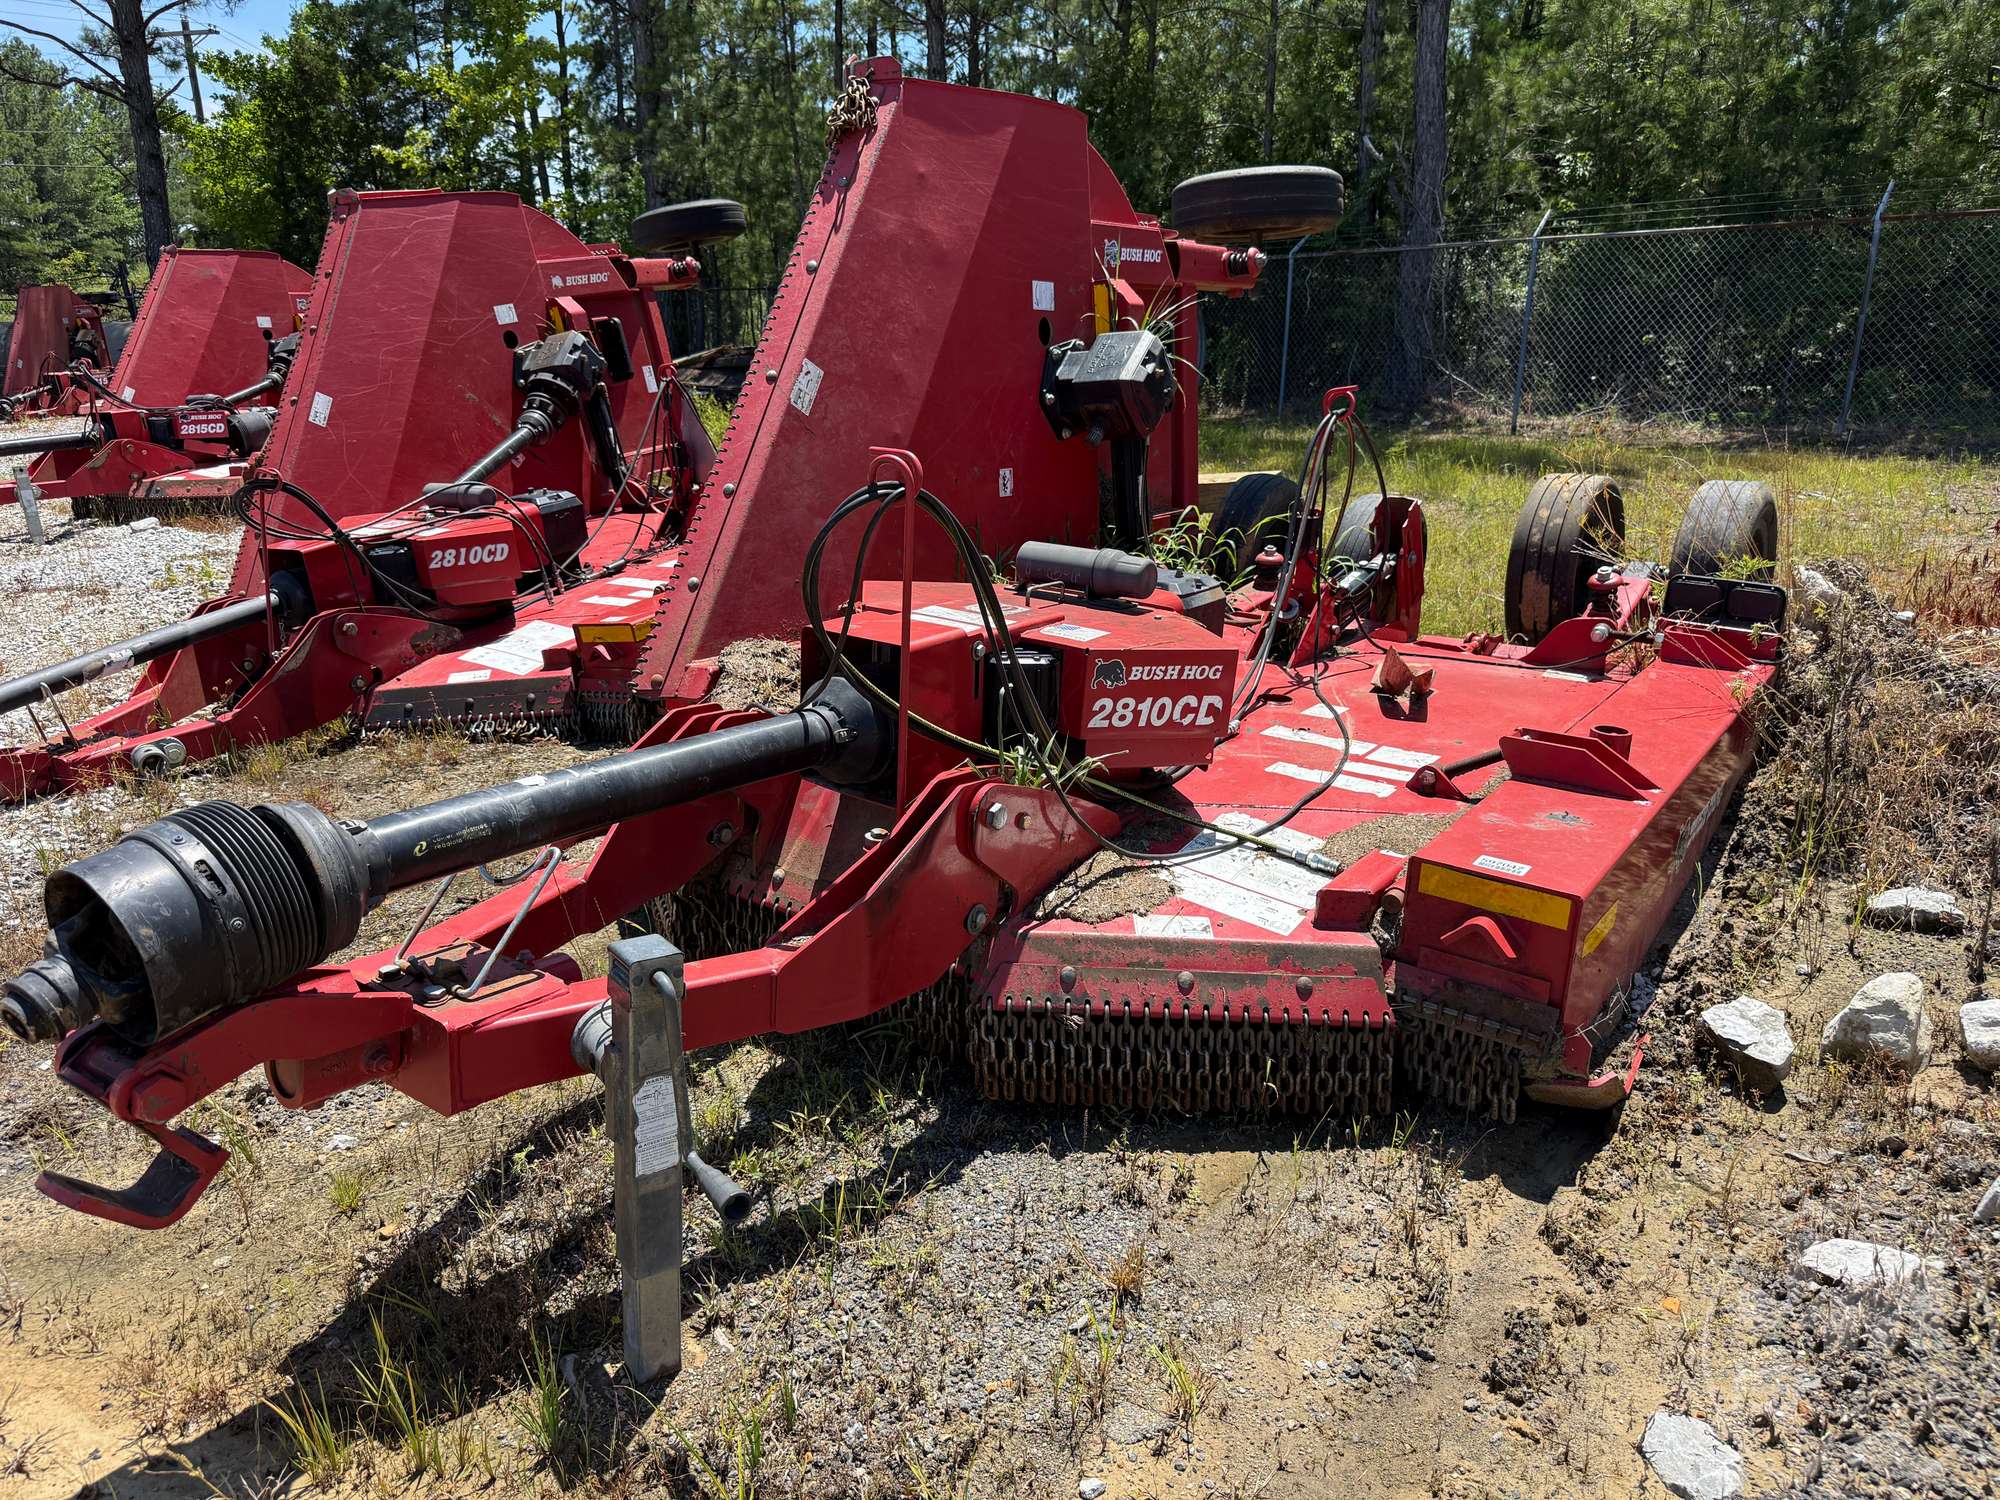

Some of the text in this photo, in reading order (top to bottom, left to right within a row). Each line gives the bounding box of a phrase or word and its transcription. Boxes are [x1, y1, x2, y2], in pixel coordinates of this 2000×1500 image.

[1121, 247, 1161, 263] BUSH HOG
[566, 272, 608, 286] BUSH HOG
[181, 423, 225, 434] 2815CD
[428, 543, 509, 569] 2810CD
[1128, 665, 1224, 681] BUSH HOG
[1087, 695, 1223, 728] 2810CD
